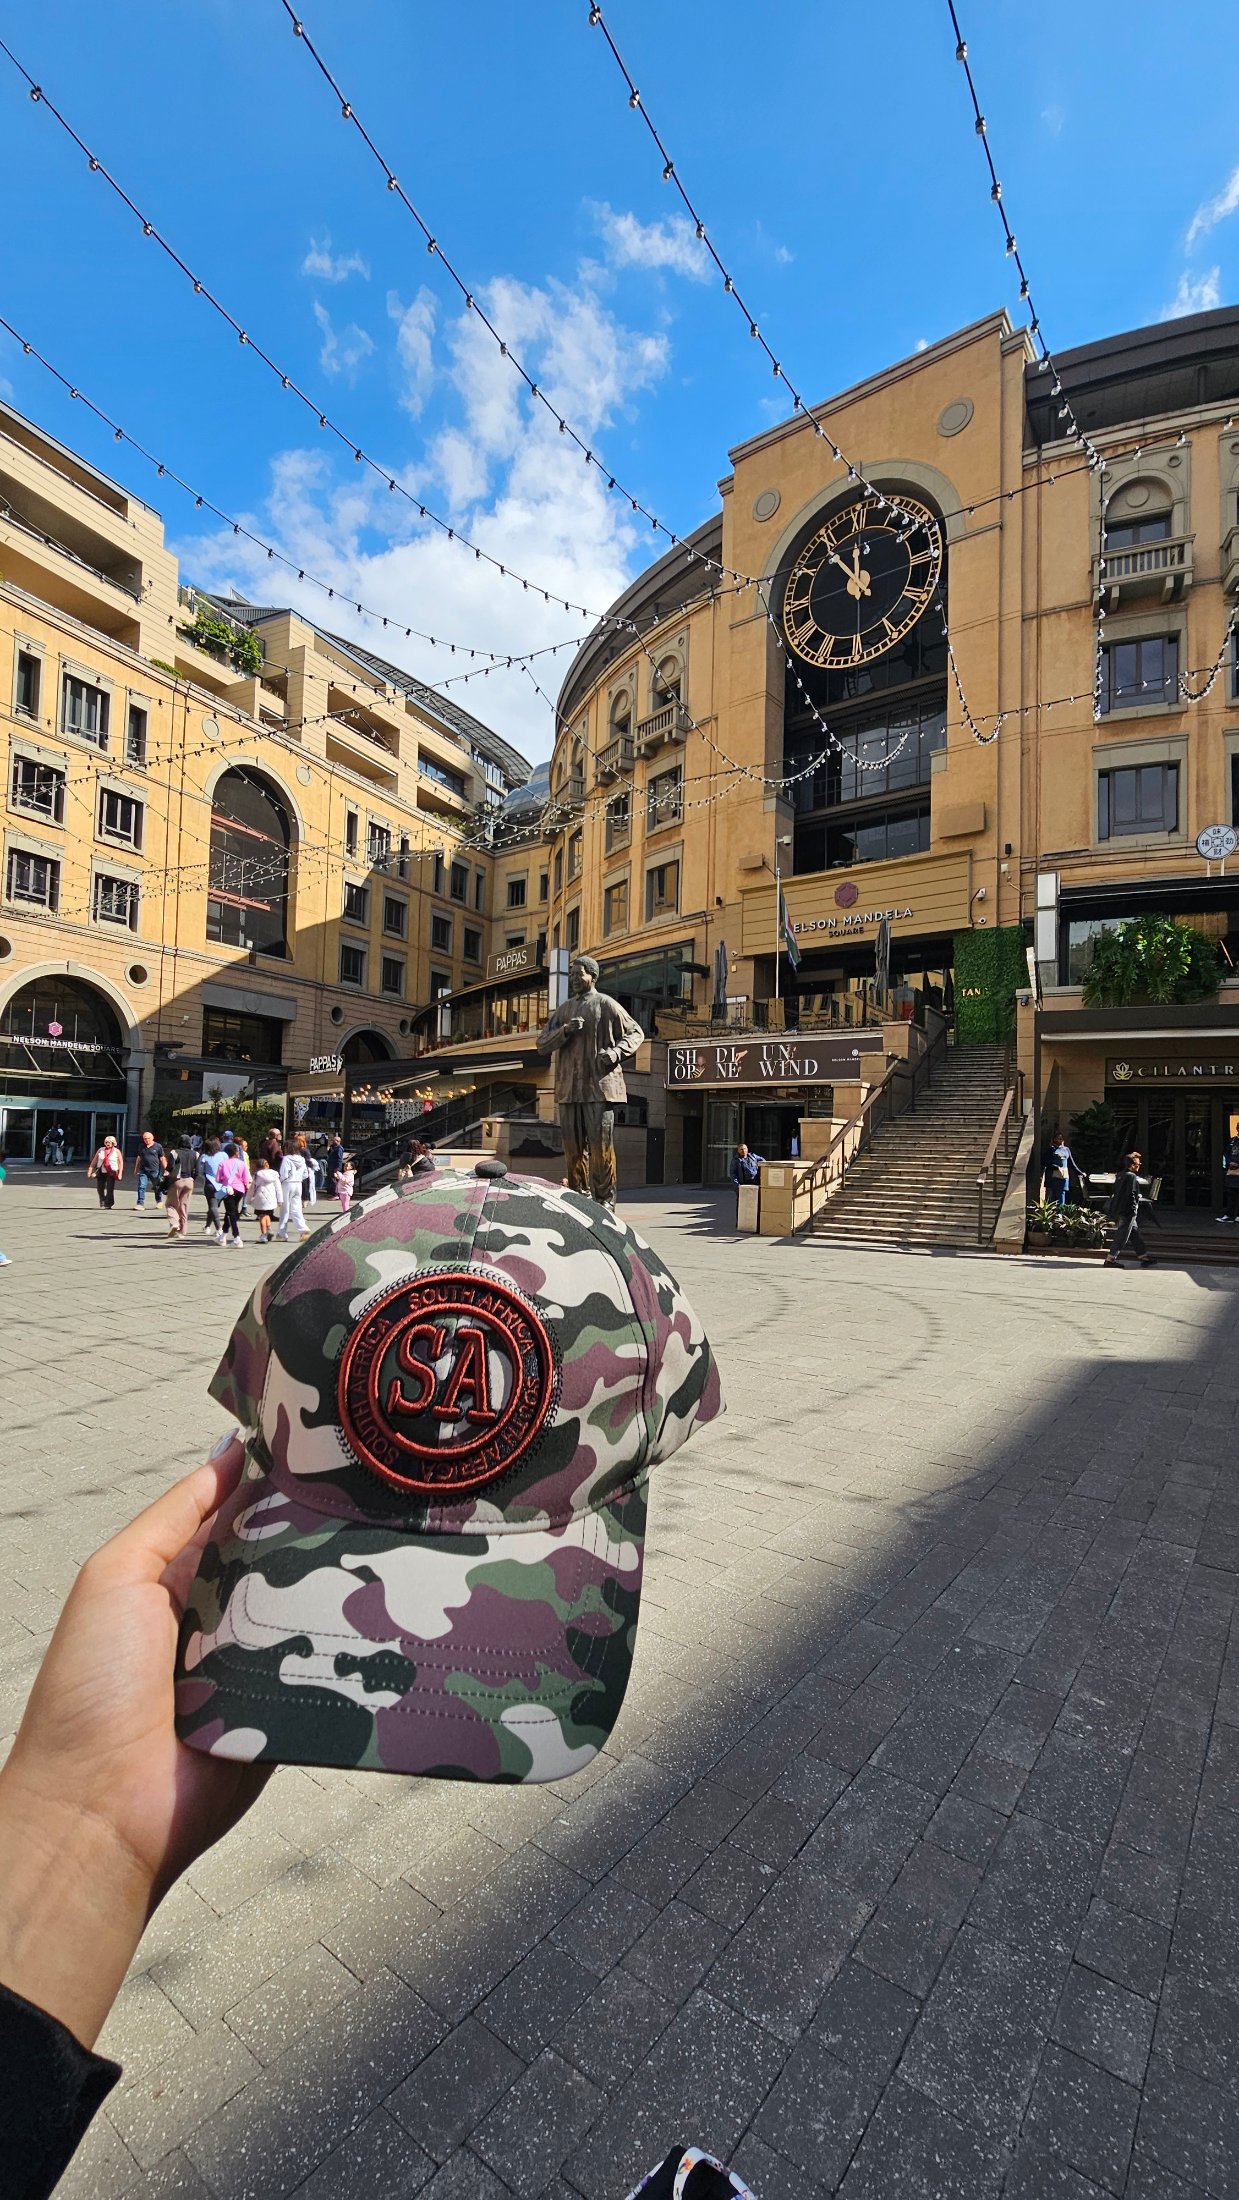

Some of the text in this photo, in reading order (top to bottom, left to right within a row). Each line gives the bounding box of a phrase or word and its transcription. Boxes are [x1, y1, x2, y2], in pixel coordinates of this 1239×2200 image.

[793, 907, 914, 934] ELSON MANDELA
[828, 926, 865, 938] SQUARE
[496, 950, 527, 972] PAPPAS
[13, 1035, 120, 1054] NELSON MANDELA SQUARE
[310, 1055, 337, 1071] PAPPAS
[759, 1058, 818, 1078] WIND
[1138, 1065, 1234, 1077] CILANTR
[408, 1284, 535, 1355] SOUTH AFRICA
[386, 1322, 497, 1423] SA
[351, 1317, 400, 1466] SOUTH AFRICA
[420, 1376, 540, 1482] SOUTH AFRICA
